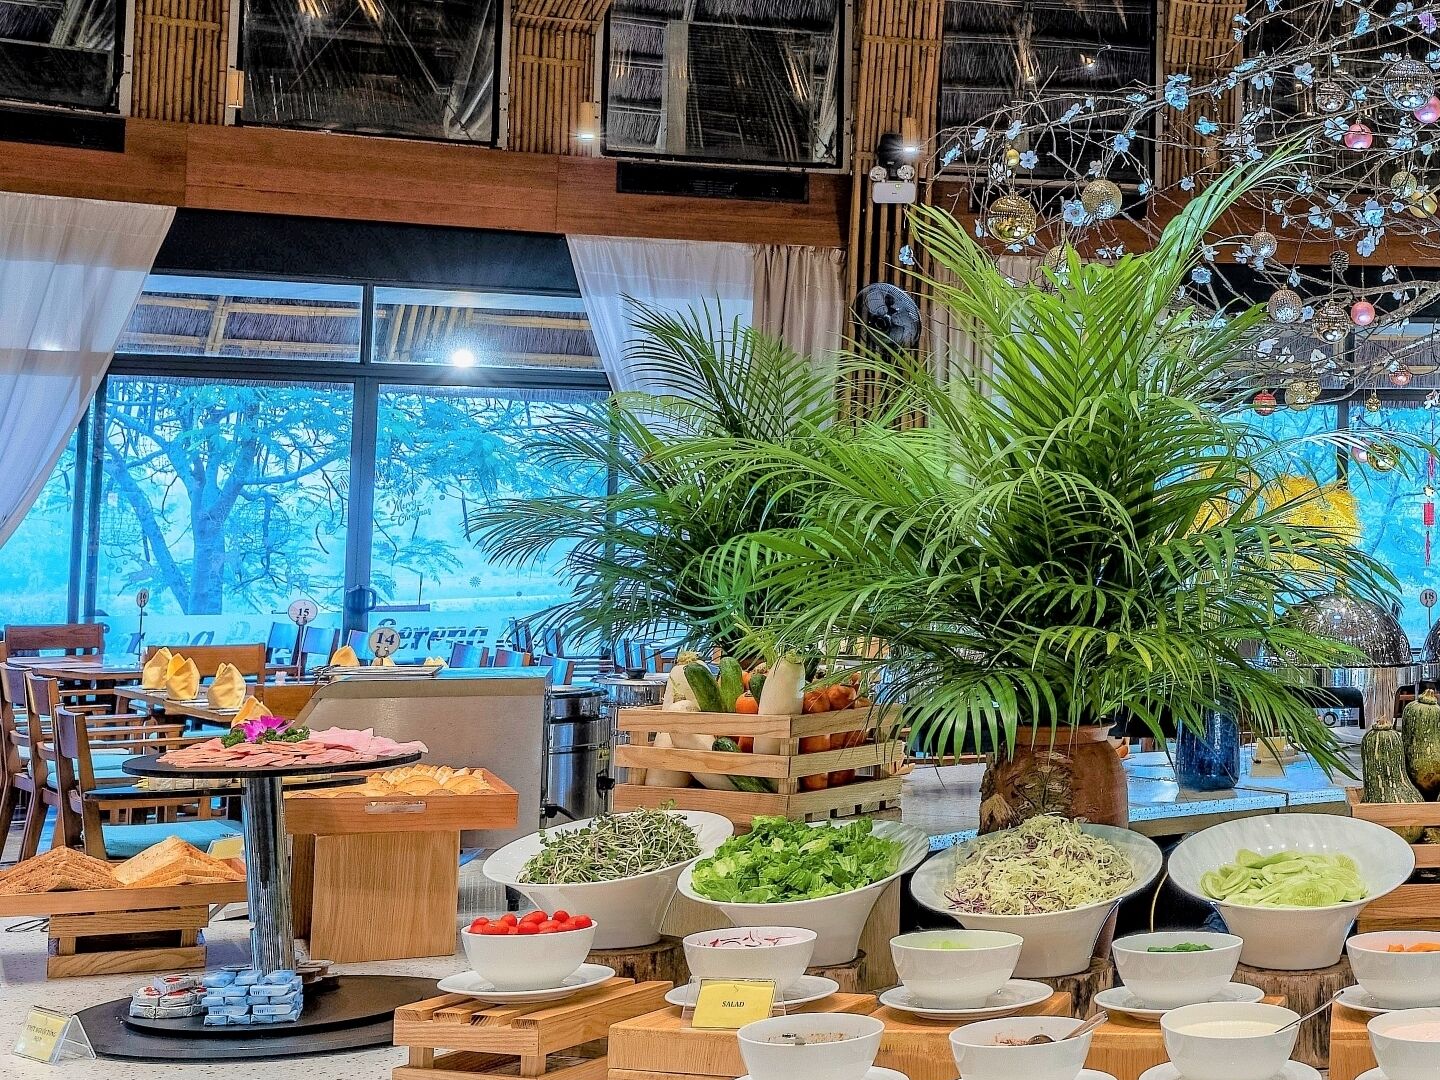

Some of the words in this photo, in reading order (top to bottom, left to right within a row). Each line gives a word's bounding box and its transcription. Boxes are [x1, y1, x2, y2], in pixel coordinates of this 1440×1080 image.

[1423, 592, 1434, 600] 18
[298, 607, 310, 617] 15
[376, 632, 395, 646] 14
[721, 1000, 745, 1008] SALAD
